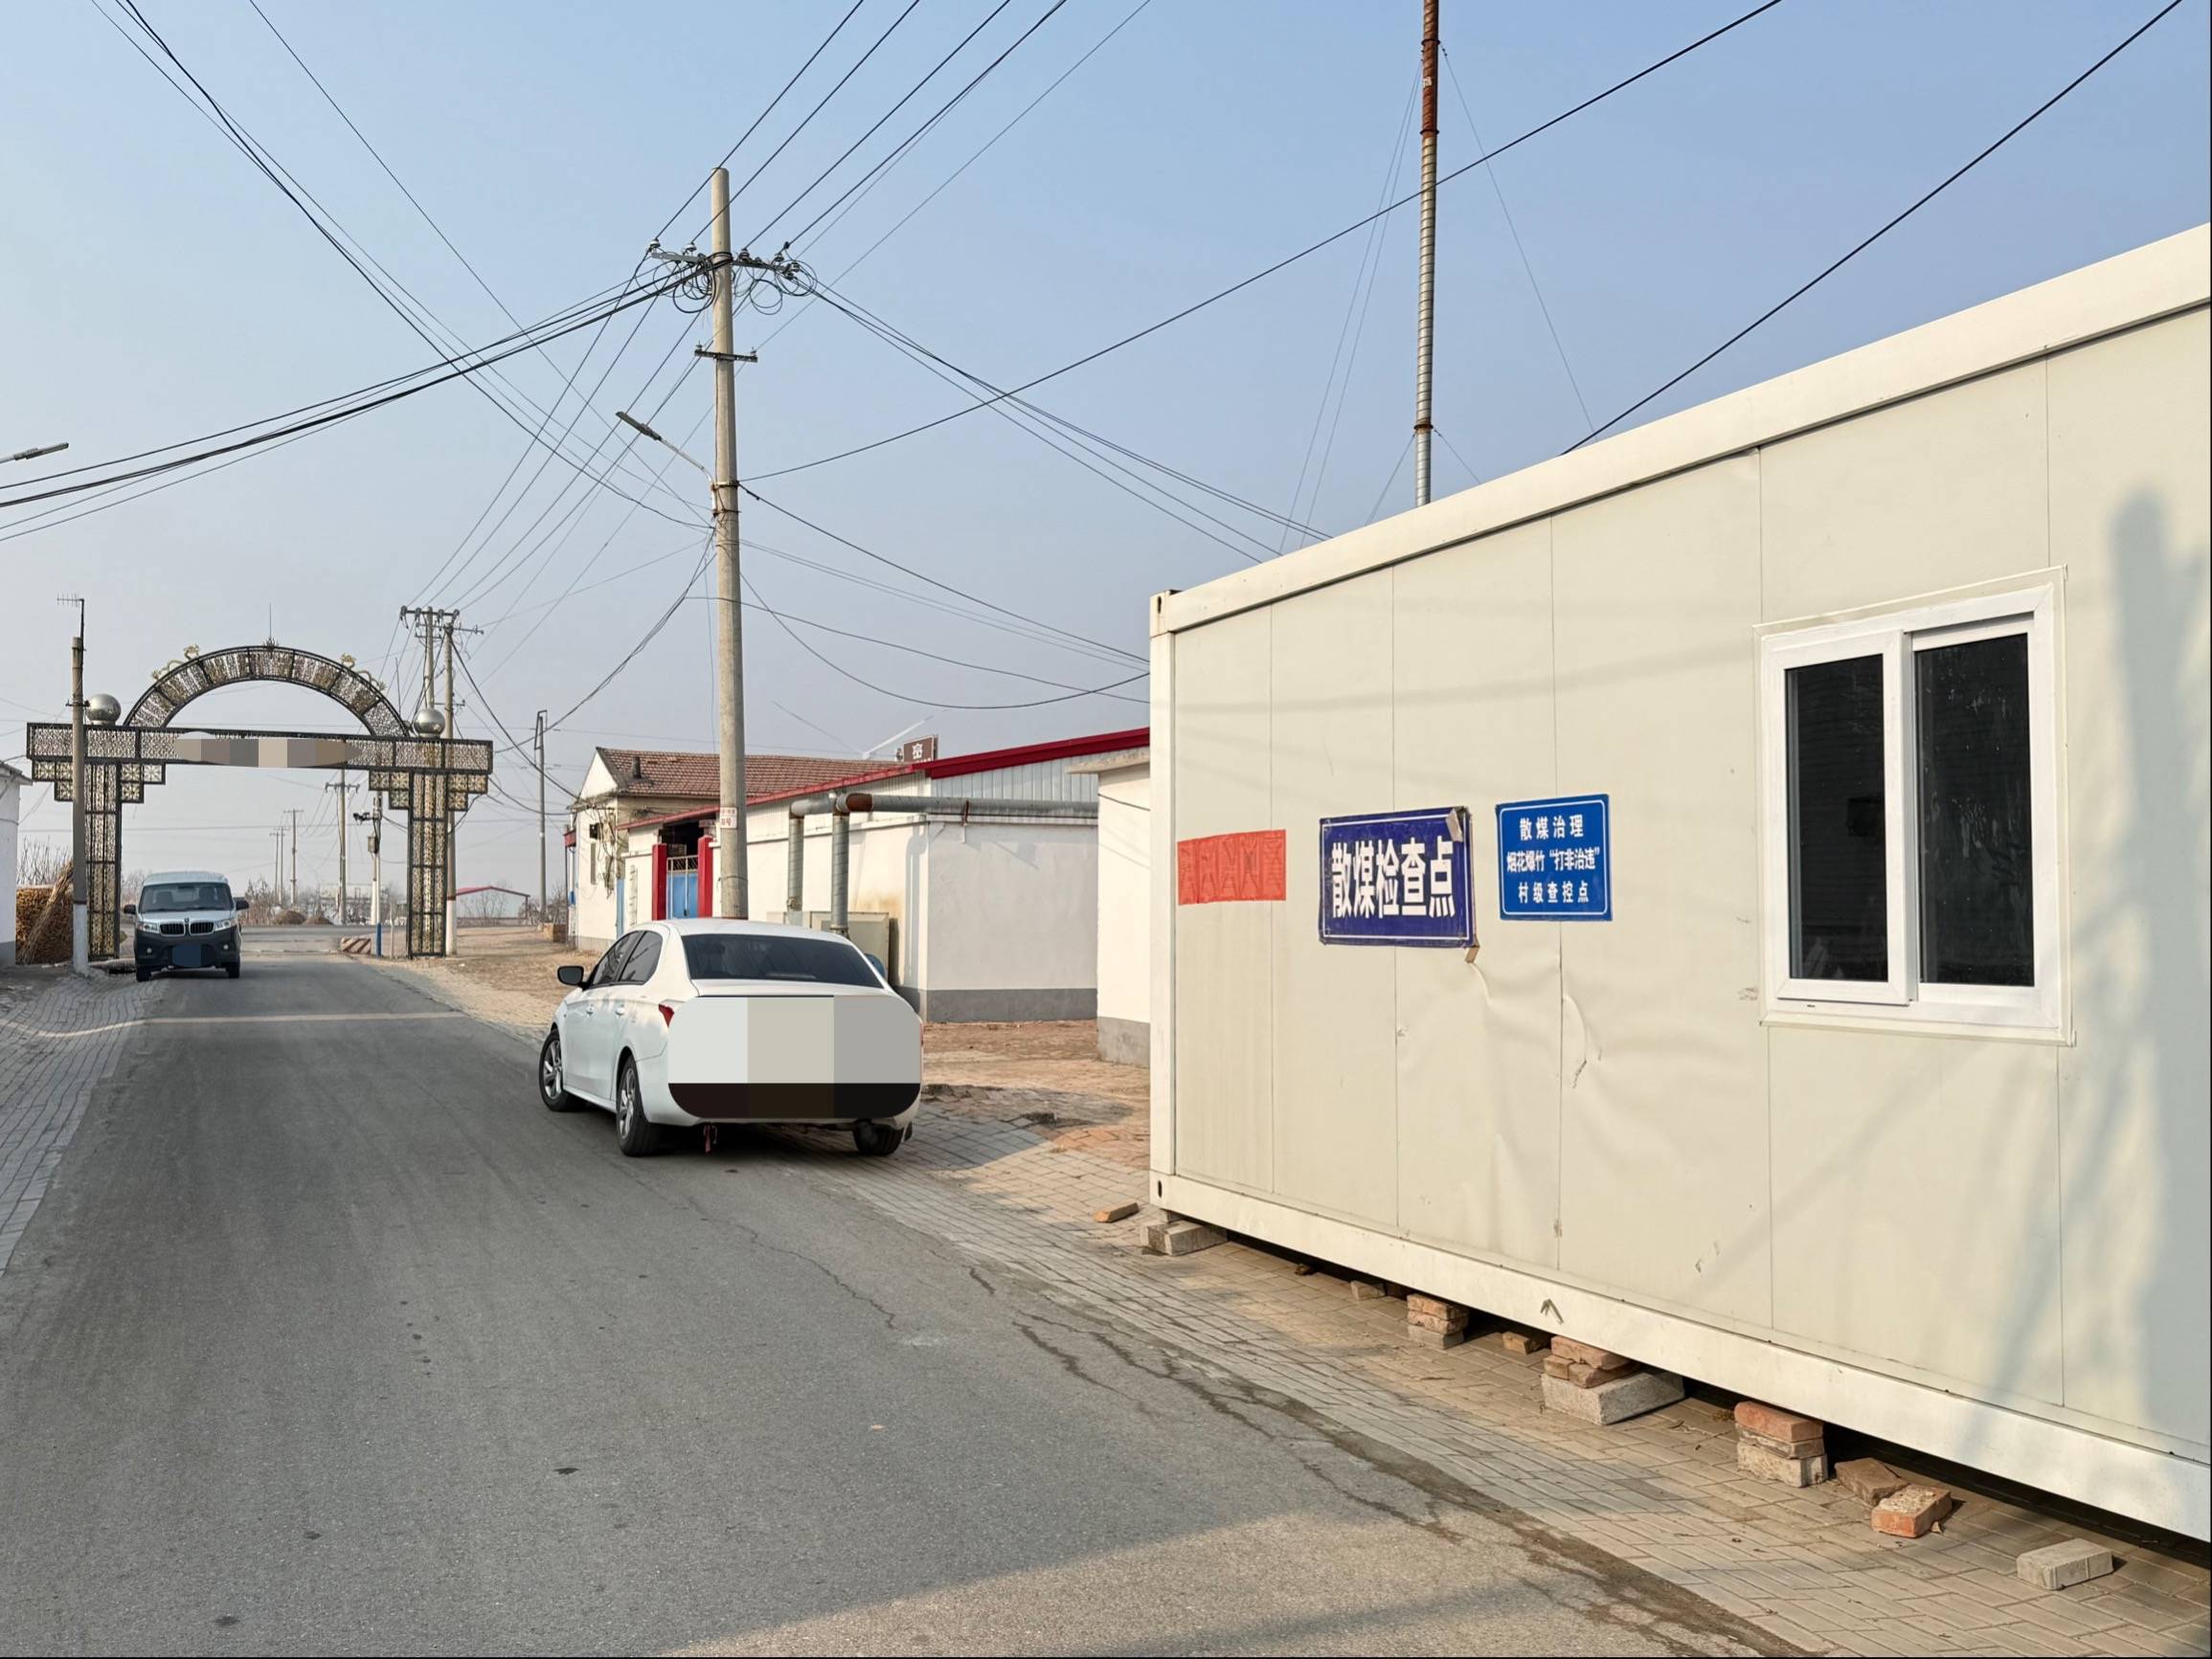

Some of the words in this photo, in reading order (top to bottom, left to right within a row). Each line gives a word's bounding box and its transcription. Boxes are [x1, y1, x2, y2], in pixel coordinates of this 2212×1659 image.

[1519, 814, 1584, 841] 散煤治理
[1331, 835, 1456, 919] 散煤检查点
[1518, 880, 1590, 904] 村级查控点
